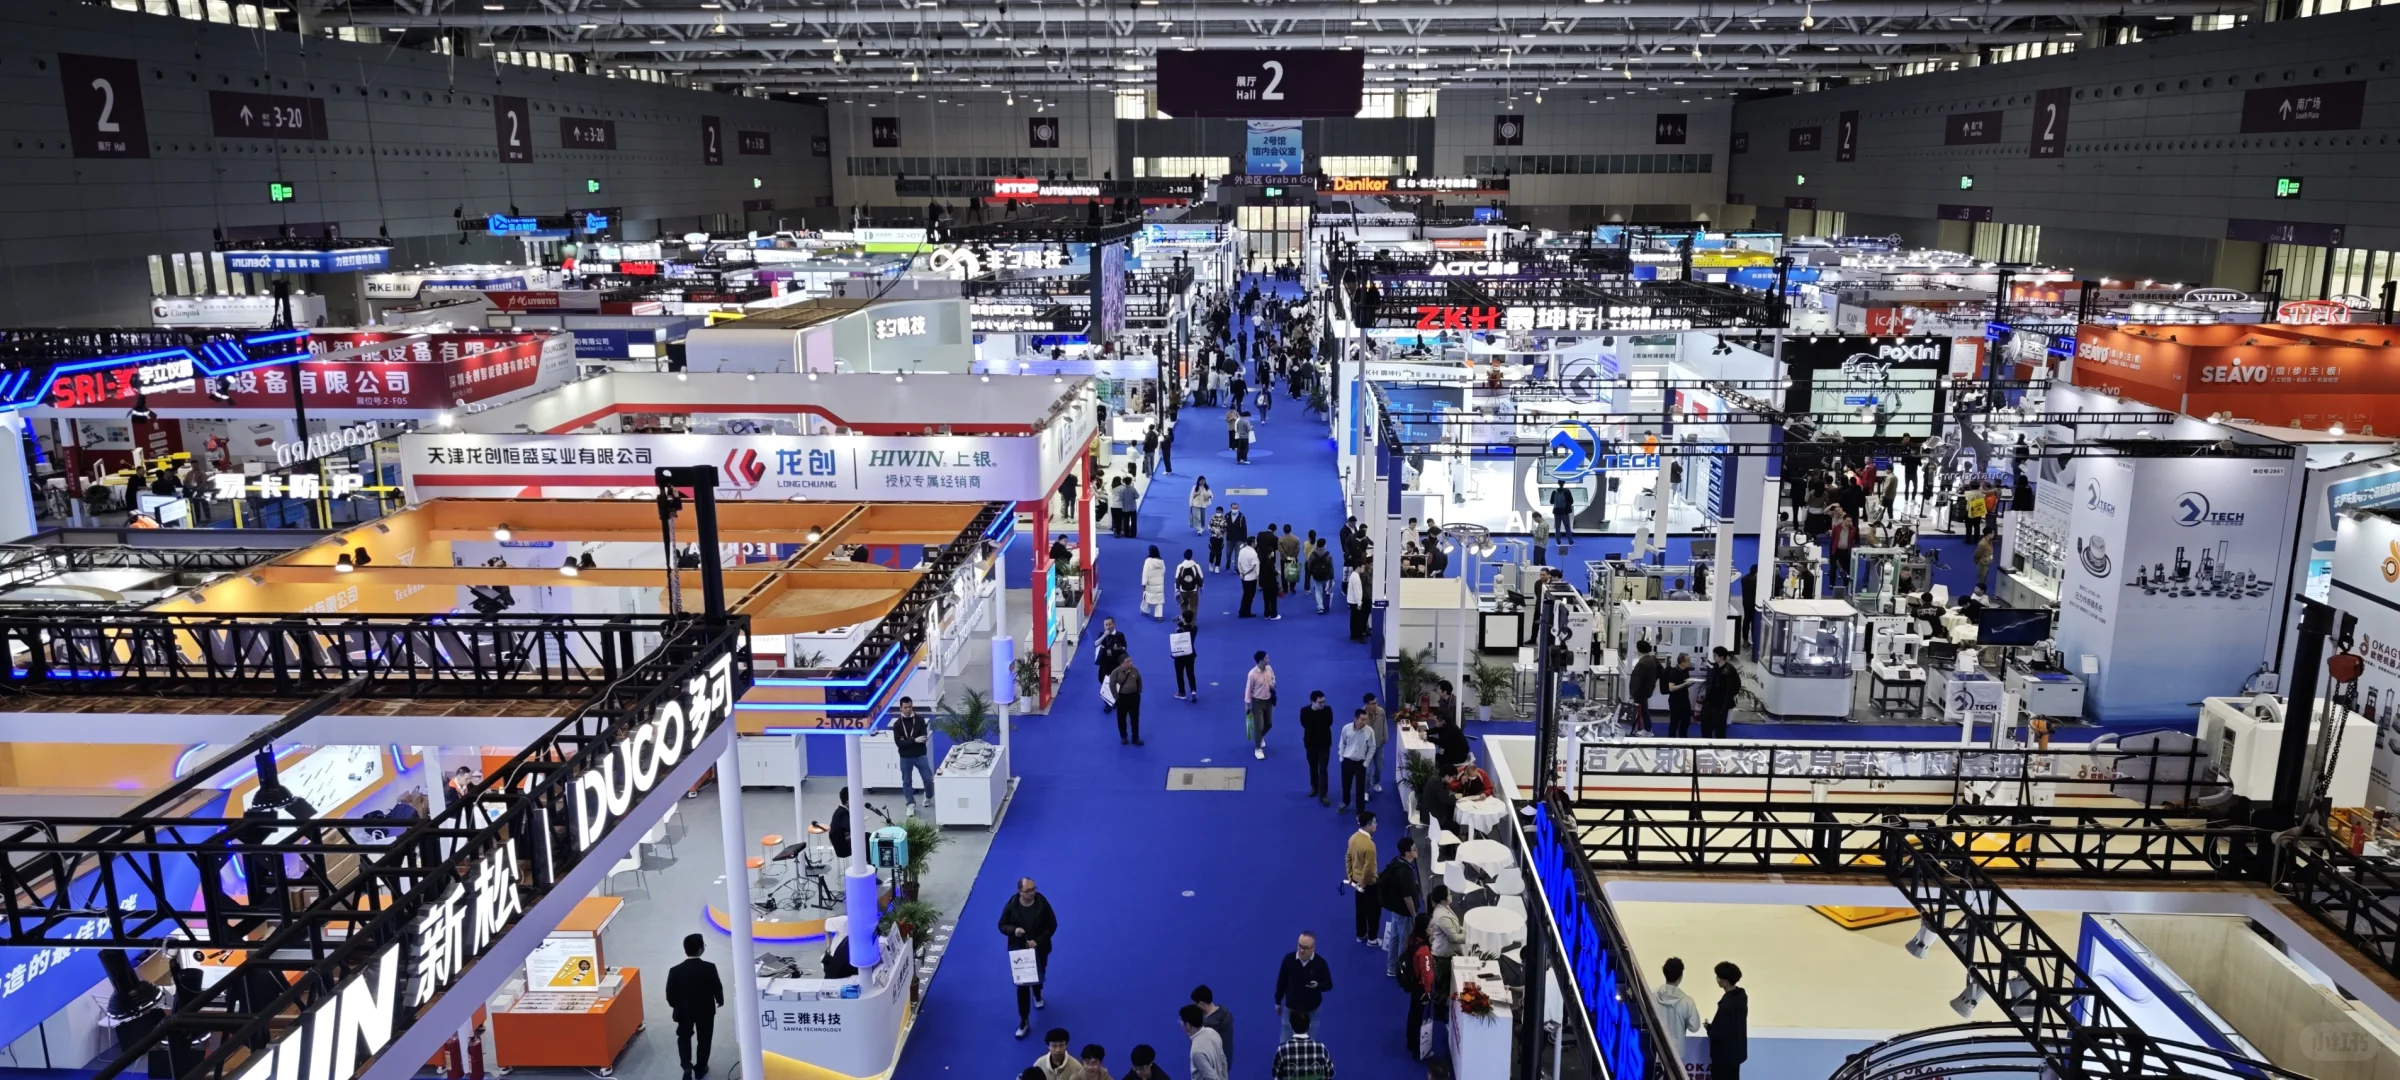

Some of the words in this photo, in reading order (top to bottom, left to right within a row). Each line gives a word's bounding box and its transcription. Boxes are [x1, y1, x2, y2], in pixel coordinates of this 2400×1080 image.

[1236, 76, 1256, 87] 展厅
[1262, 60, 1285, 100] 2
[1236, 90, 1256, 100] Hall
[91, 77, 120, 133] 2
[2296, 97, 2321, 110] 南广场
[273, 106, 303, 128] 3-20
[2043, 103, 2057, 141] 2
[507, 110, 520, 147] 2
[590, 127, 605, 143] 3-20
[1844, 121, 1852, 149] 2
[708, 126, 716, 153] 2
[1263, 136, 1286, 146] 2号馆
[1252, 147, 1297, 156] 馆内会议室
[1234, 175, 1263, 185] 外卖区
[1265, 175, 1289, 184] Grab
[1299, 175, 1314, 184] Go
[1333, 177, 1389, 191] Danikor
[1039, 186, 1100, 196] AUTOMATION
[1168, 186, 1193, 194] 2-M28
[2282, 225, 2295, 242] 14
[368, 283, 392, 292] RKE
[1416, 306, 1500, 330] ZKH
[138, 358, 194, 384] 宇立仪器
[2200, 357, 2267, 384] SEAVO
[428, 447, 653, 465] 天津龙创恒盛实业有限公司
[775, 448, 837, 477] 龙创
[868, 449, 945, 468] HIWIN
[952, 450, 991, 468] 上银
[777, 480, 801, 488] LONG
[801, 480, 838, 488] CHUANG
[885, 474, 982, 489] 授权专属经销商
[2211, 512, 2245, 521] TECH
[815, 717, 865, 730] 2-M26
[575, 700, 685, 852] DUCO
[689, 652, 733, 750] 多可
[415, 837, 523, 1008] 新松
[782, 1012, 842, 1026] 三雅科技
